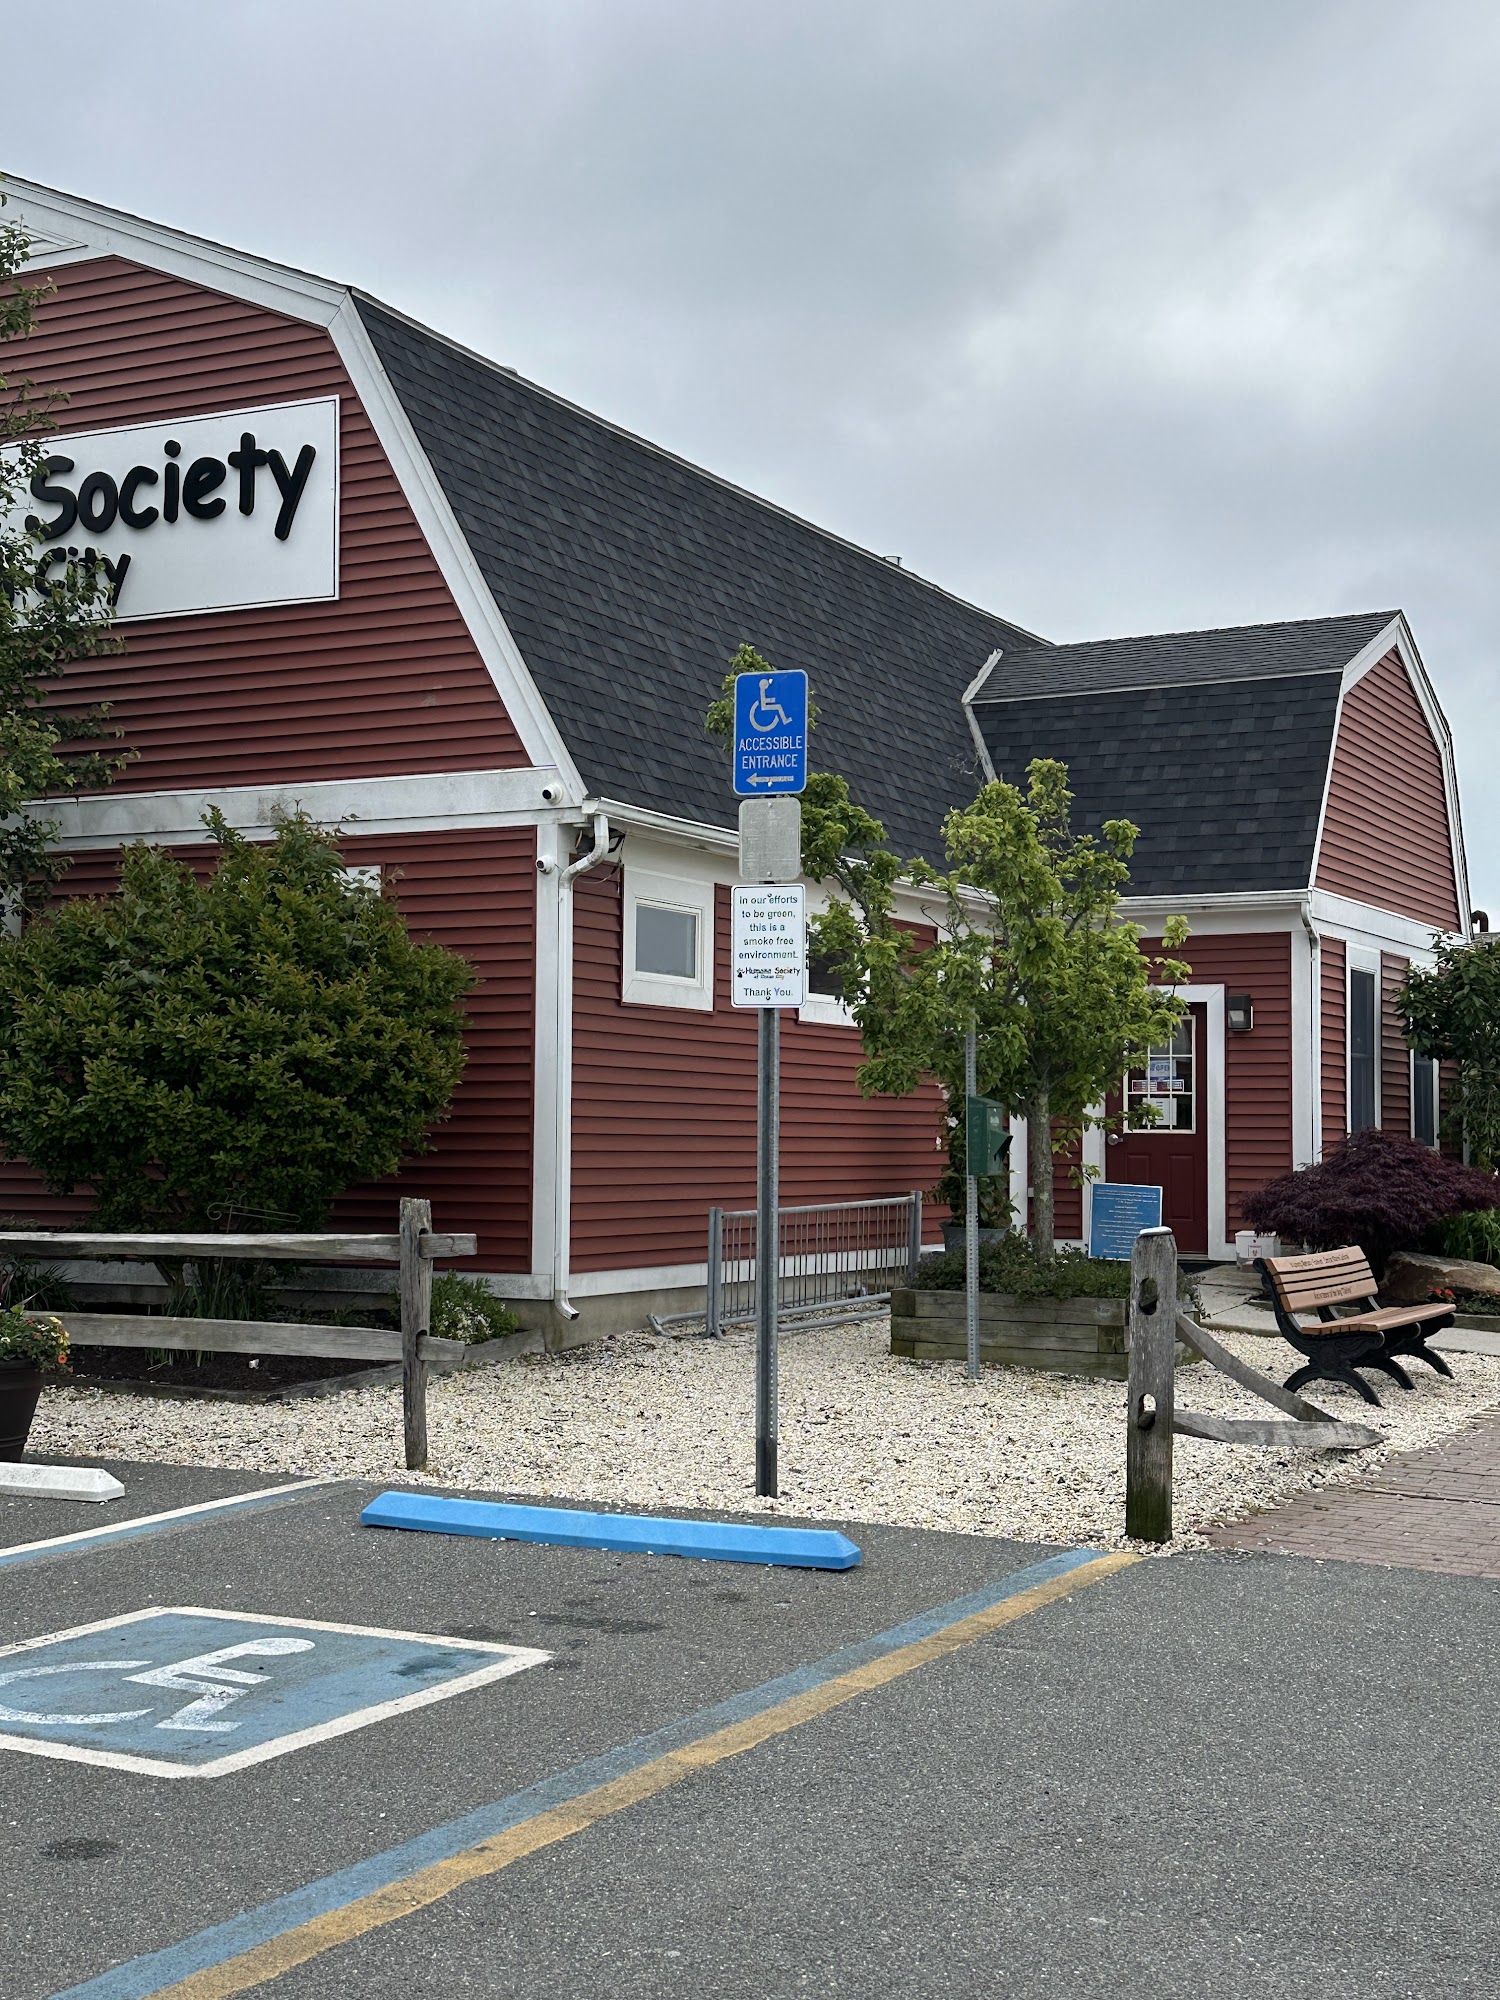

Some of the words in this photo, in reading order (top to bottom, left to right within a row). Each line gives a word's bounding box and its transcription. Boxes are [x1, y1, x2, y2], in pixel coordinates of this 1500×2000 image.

[25, 432, 317, 541] Society
[34, 546, 132, 607] City
[738, 735, 803, 752] ACCESSIBLE
[742, 754, 798, 769] ENTRANCE
[768, 894, 798, 904] efforts
[741, 910, 751, 918] to
[753, 909, 765, 918] be
[767, 911, 796, 920] green,
[749, 923, 767, 932] this
[769, 923, 777, 931] is
[743, 937, 773, 945] smoke
[776, 936, 794, 945] free
[738, 951, 799, 959] environment.
[745, 967, 772, 975] Humane
[774, 967, 801, 976] Society
[743, 987, 772, 996] Thank
[773, 987, 794, 996] You.
